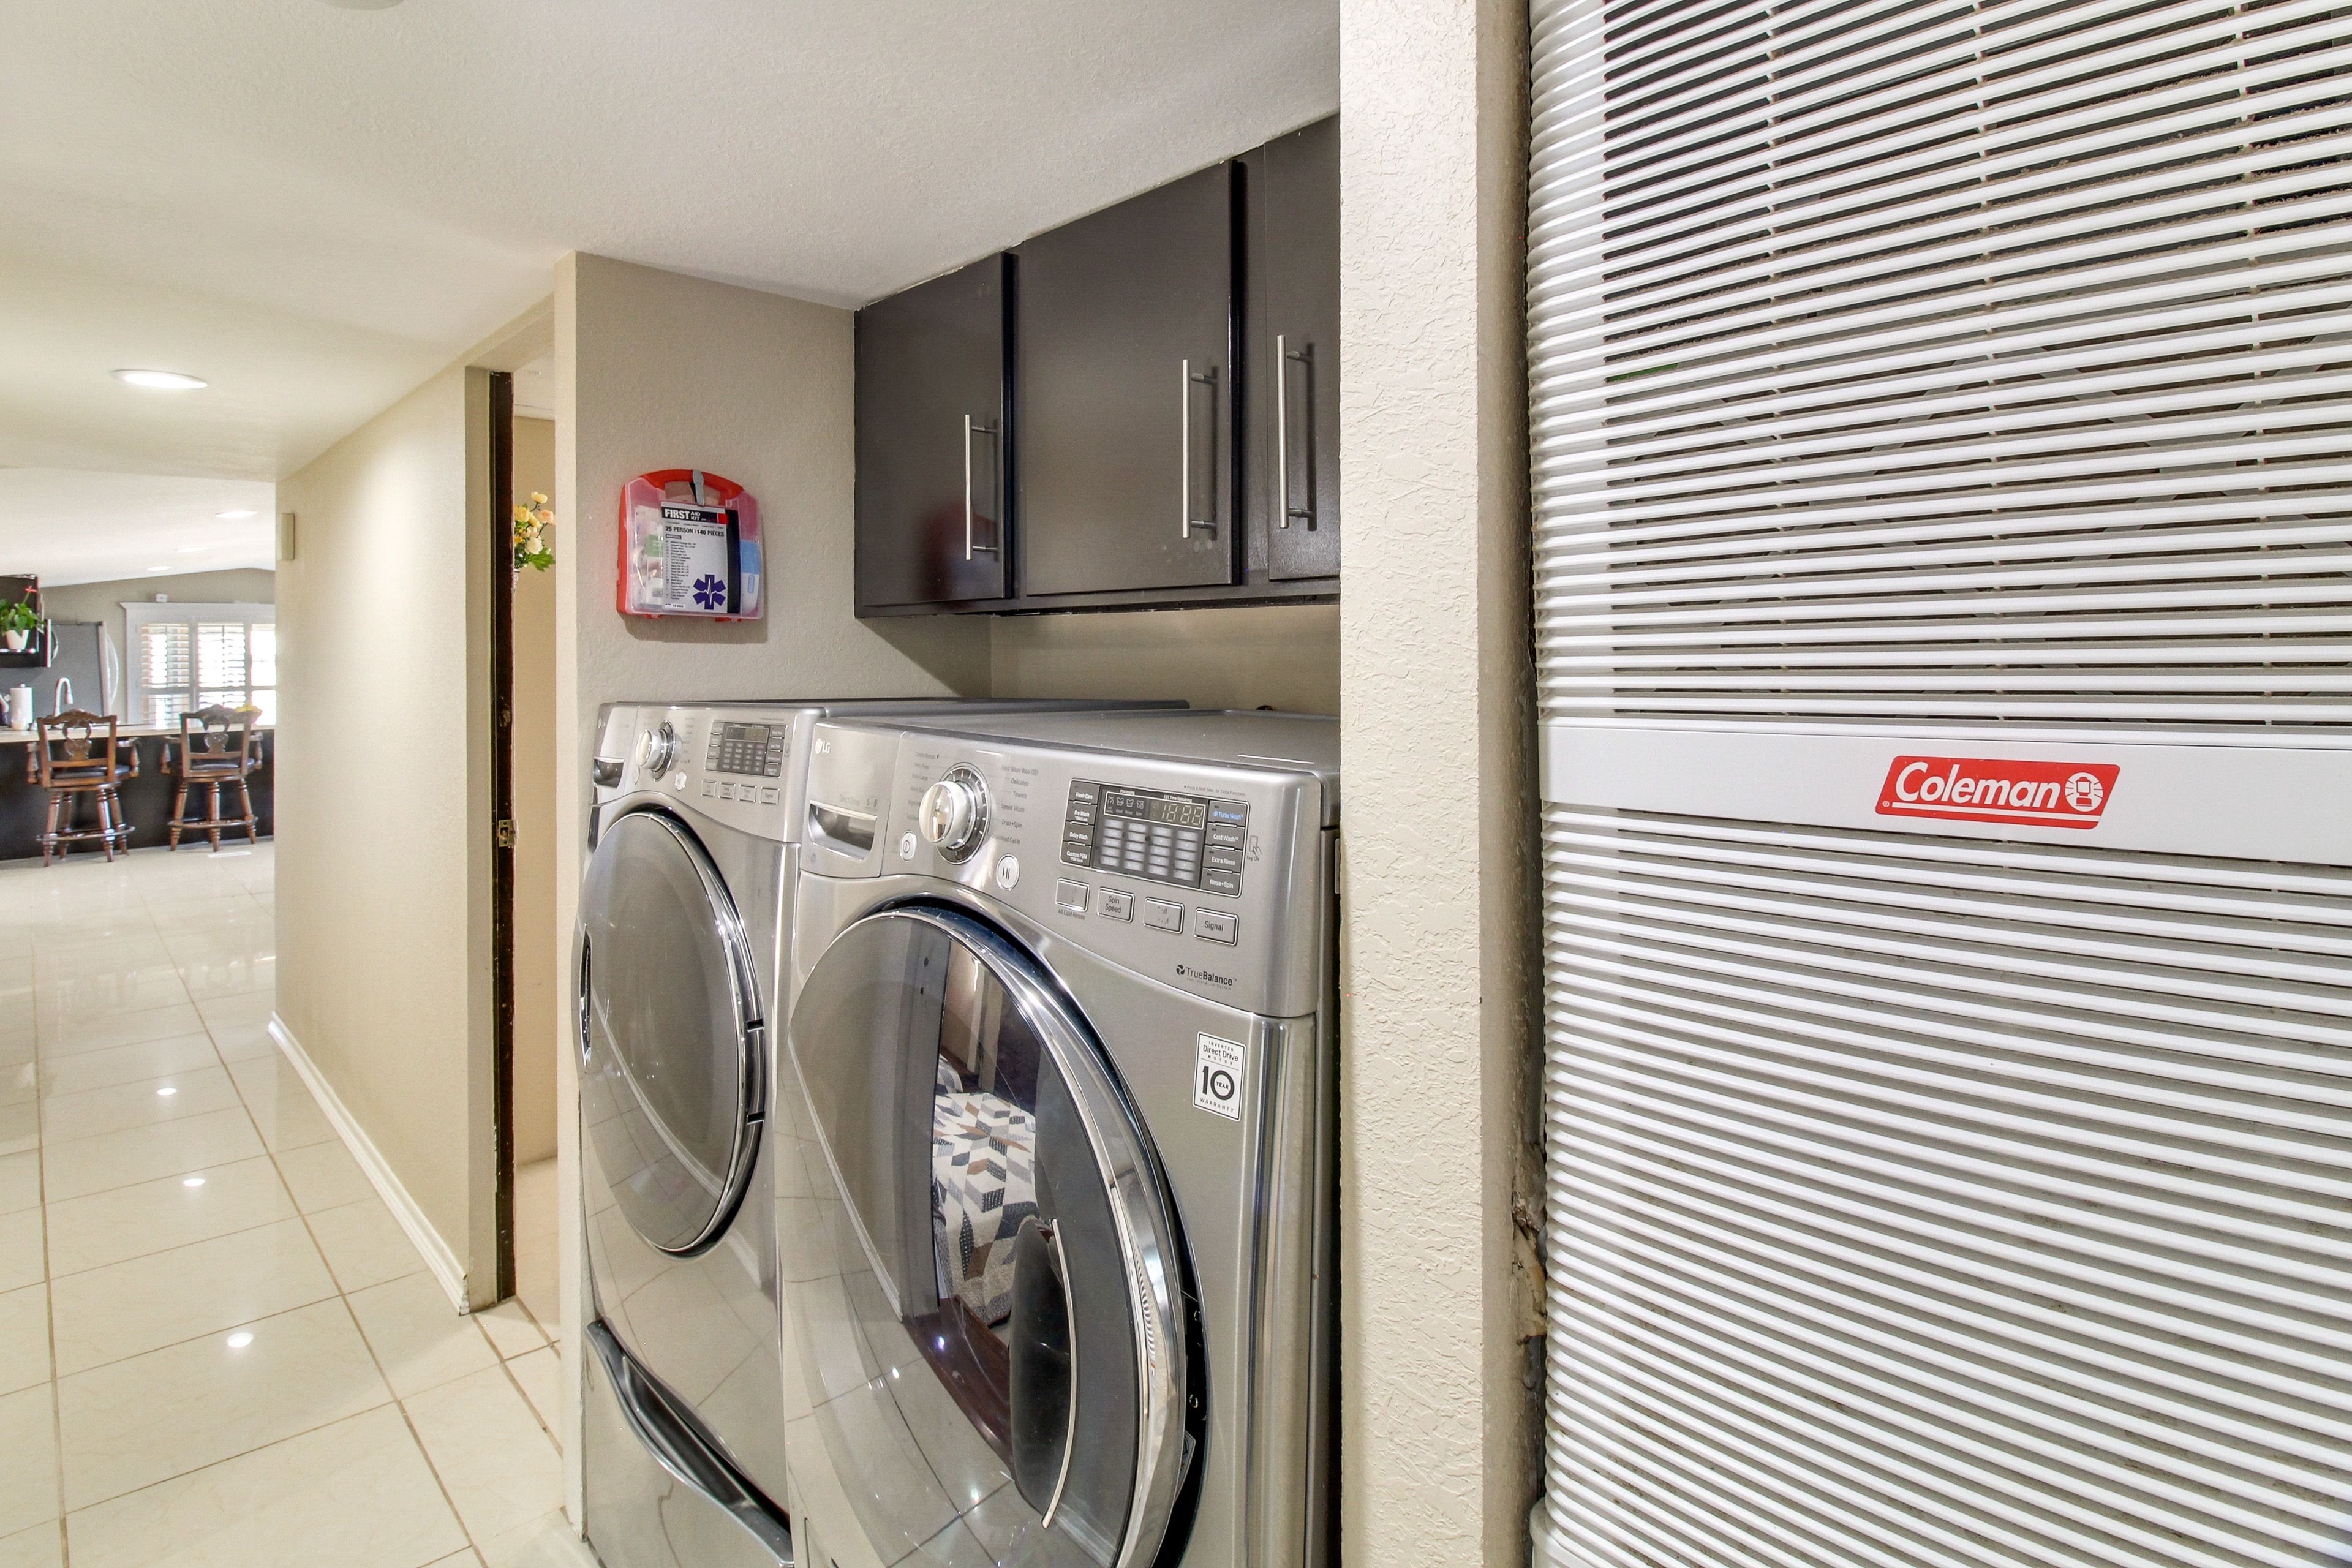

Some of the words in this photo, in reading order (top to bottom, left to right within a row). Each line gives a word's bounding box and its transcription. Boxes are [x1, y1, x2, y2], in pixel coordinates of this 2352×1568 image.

[665, 508, 690, 519] FIRST
[1896, 761, 2061, 809] Coleman
[1108, 895, 1120, 905] Spin
[1104, 903, 1121, 914] Speed
[1204, 920, 1224, 932] Signal
[1208, 1041, 1234, 1052] INVERTER
[1203, 1044, 1221, 1057] Direct
[1222, 1050, 1238, 1062] Drive
[1208, 1055, 1233, 1065] MOTOR
[1202, 1065, 1235, 1101] 10
[1216, 1081, 1229, 1090] YEAR
[1200, 1097, 1234, 1113] WARRANTY
